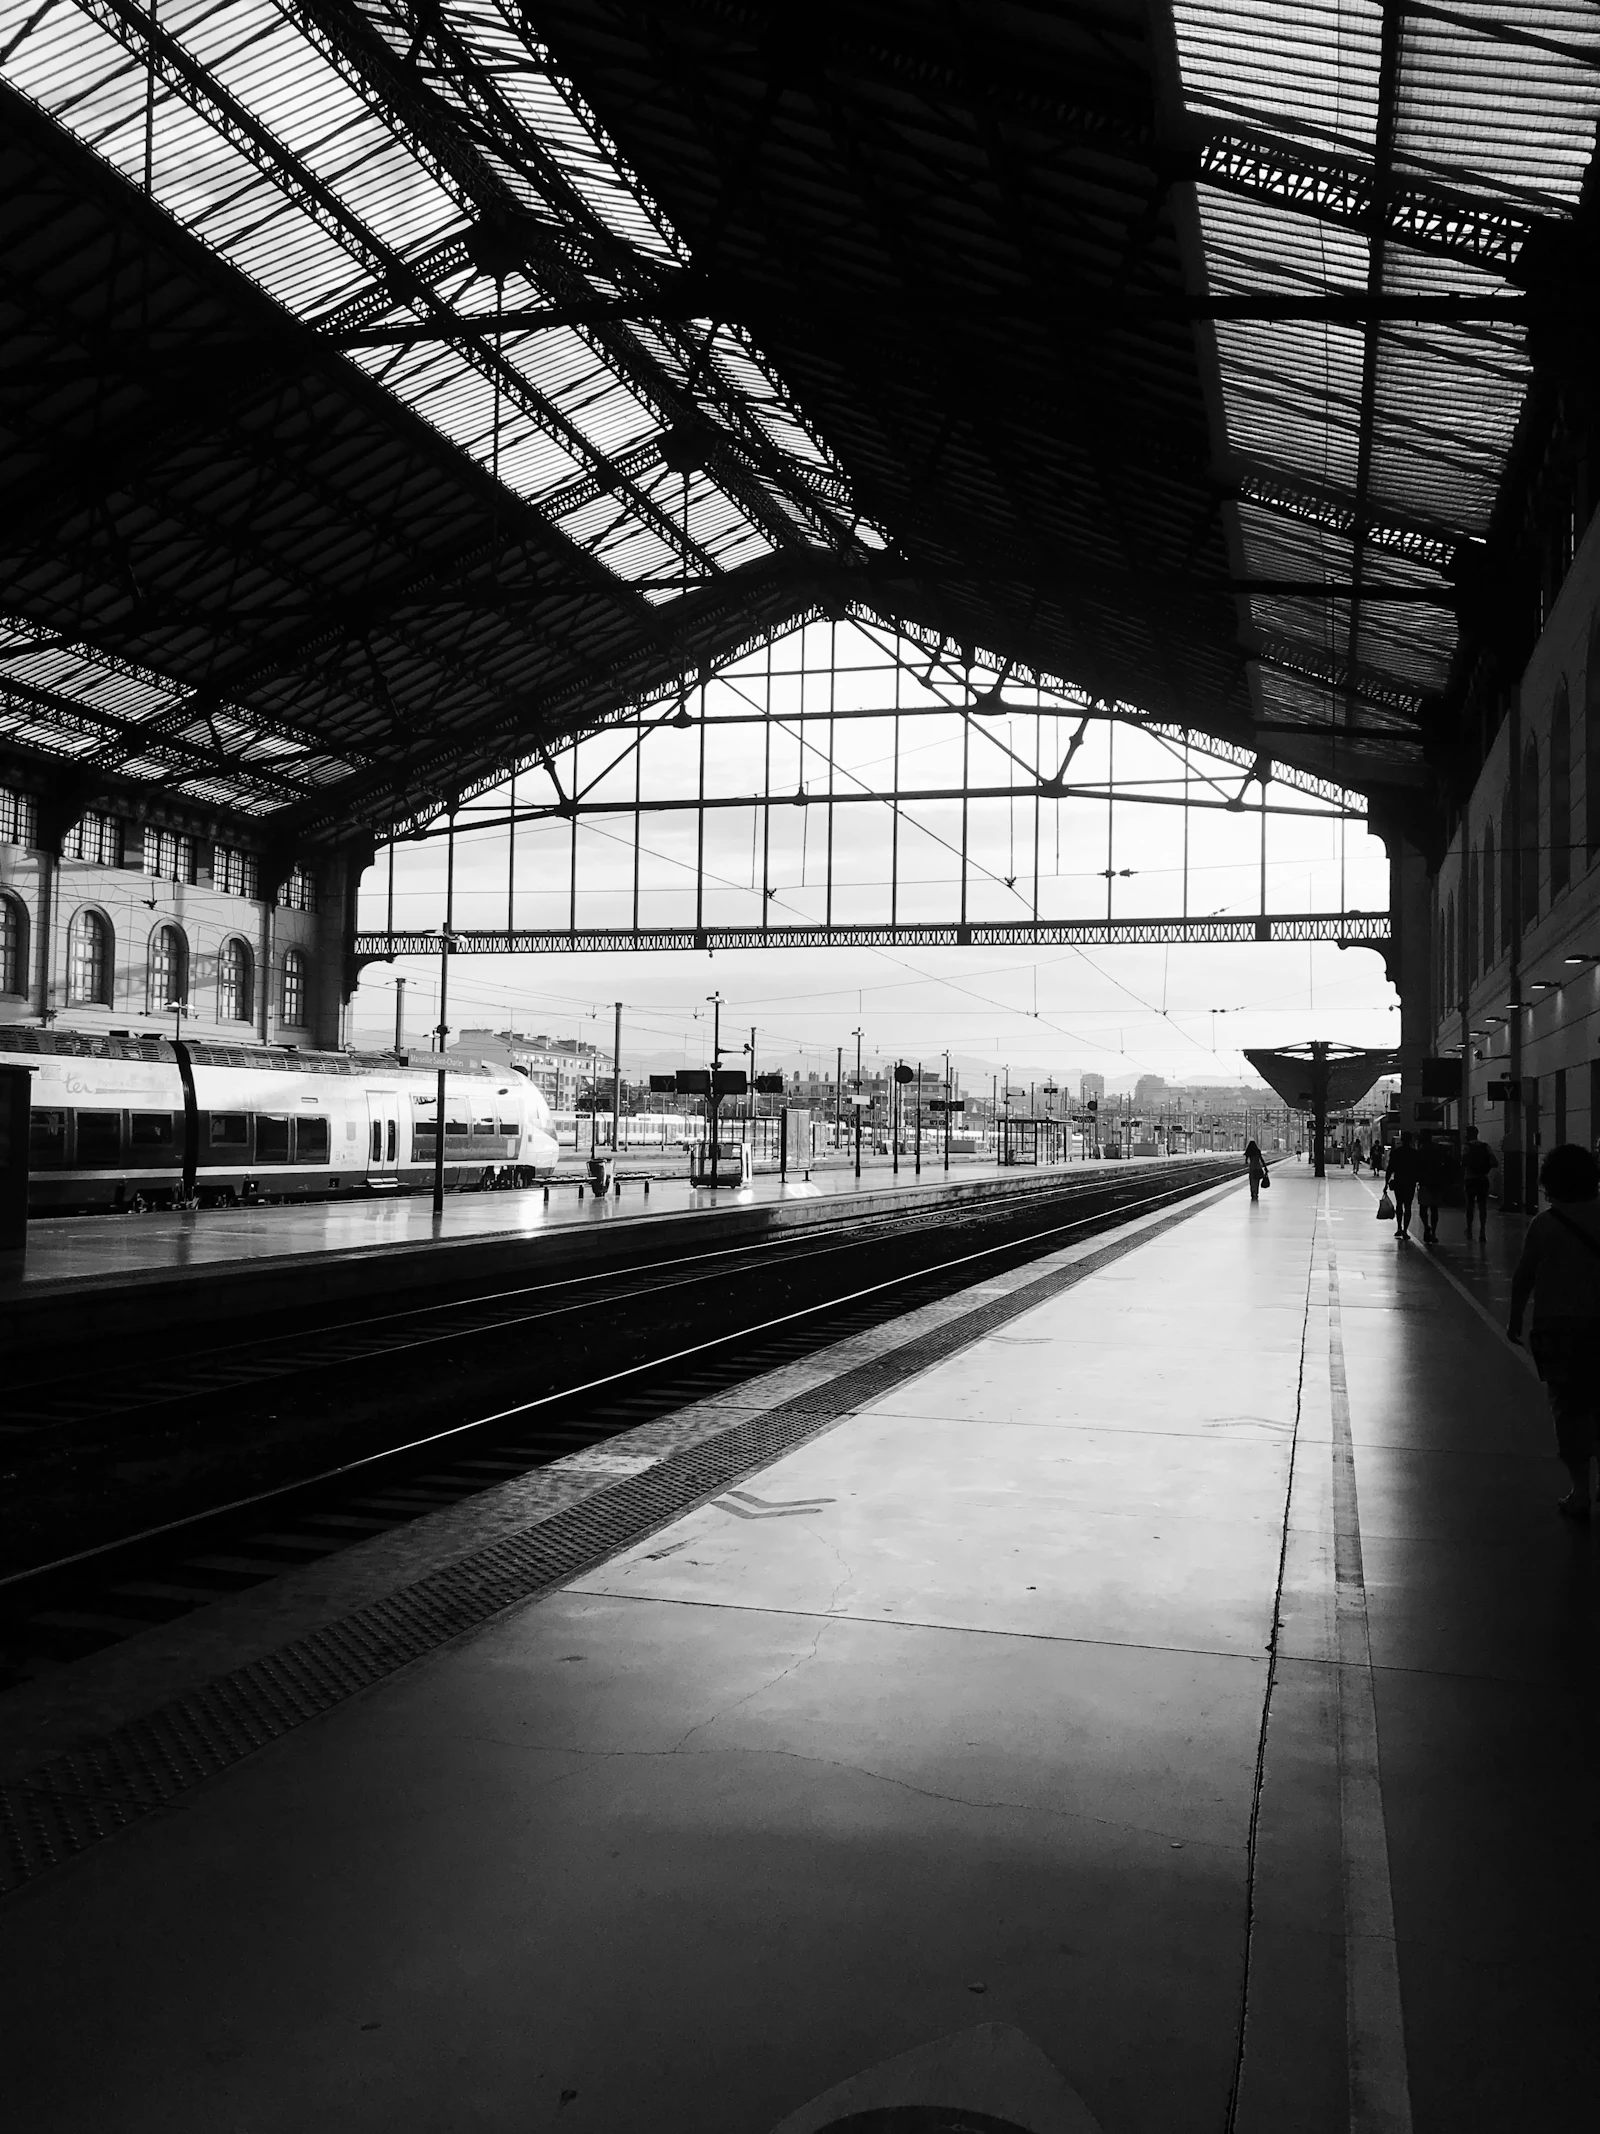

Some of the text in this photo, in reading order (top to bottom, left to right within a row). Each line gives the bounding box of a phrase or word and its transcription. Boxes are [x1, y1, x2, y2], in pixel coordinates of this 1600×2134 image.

[63, 1070, 93, 1094] ter
[663, 1079, 671, 1091] Y
[762, 1079, 770, 1091] Y
[1503, 1085, 1515, 1100] Y
